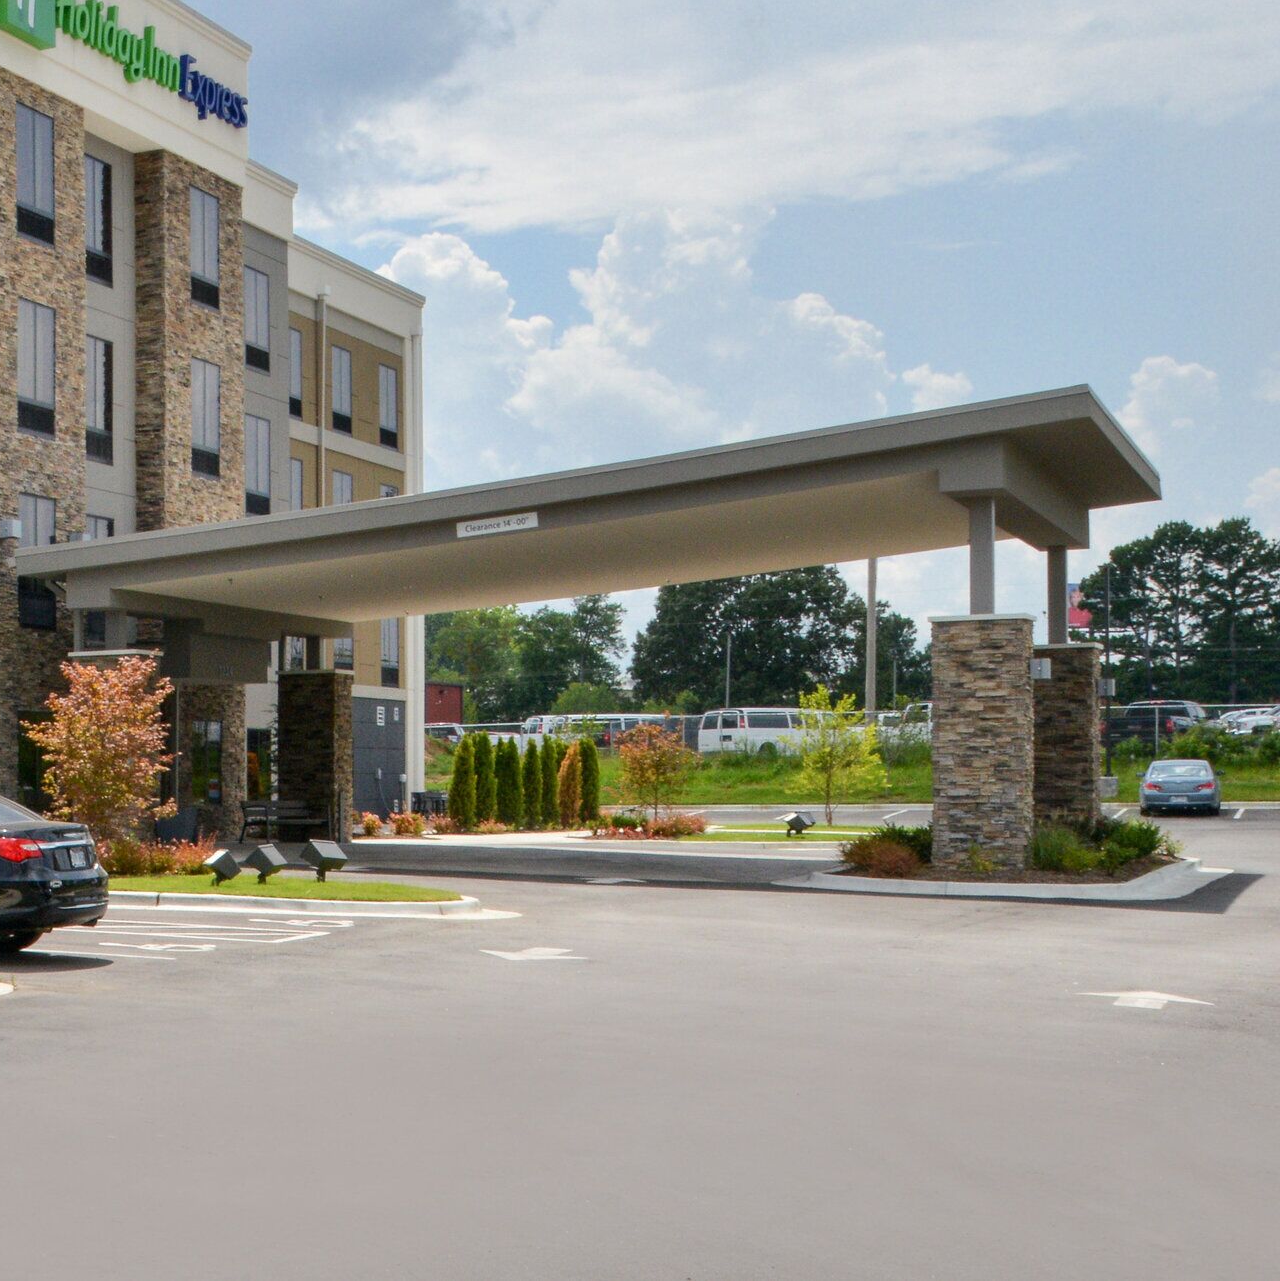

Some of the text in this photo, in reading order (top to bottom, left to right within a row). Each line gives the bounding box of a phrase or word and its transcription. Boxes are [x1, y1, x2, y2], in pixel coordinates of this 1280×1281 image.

[143, 25, 181, 93] Inn
[180, 54, 249, 129] Express
[465, 522, 502, 533] Clearance
